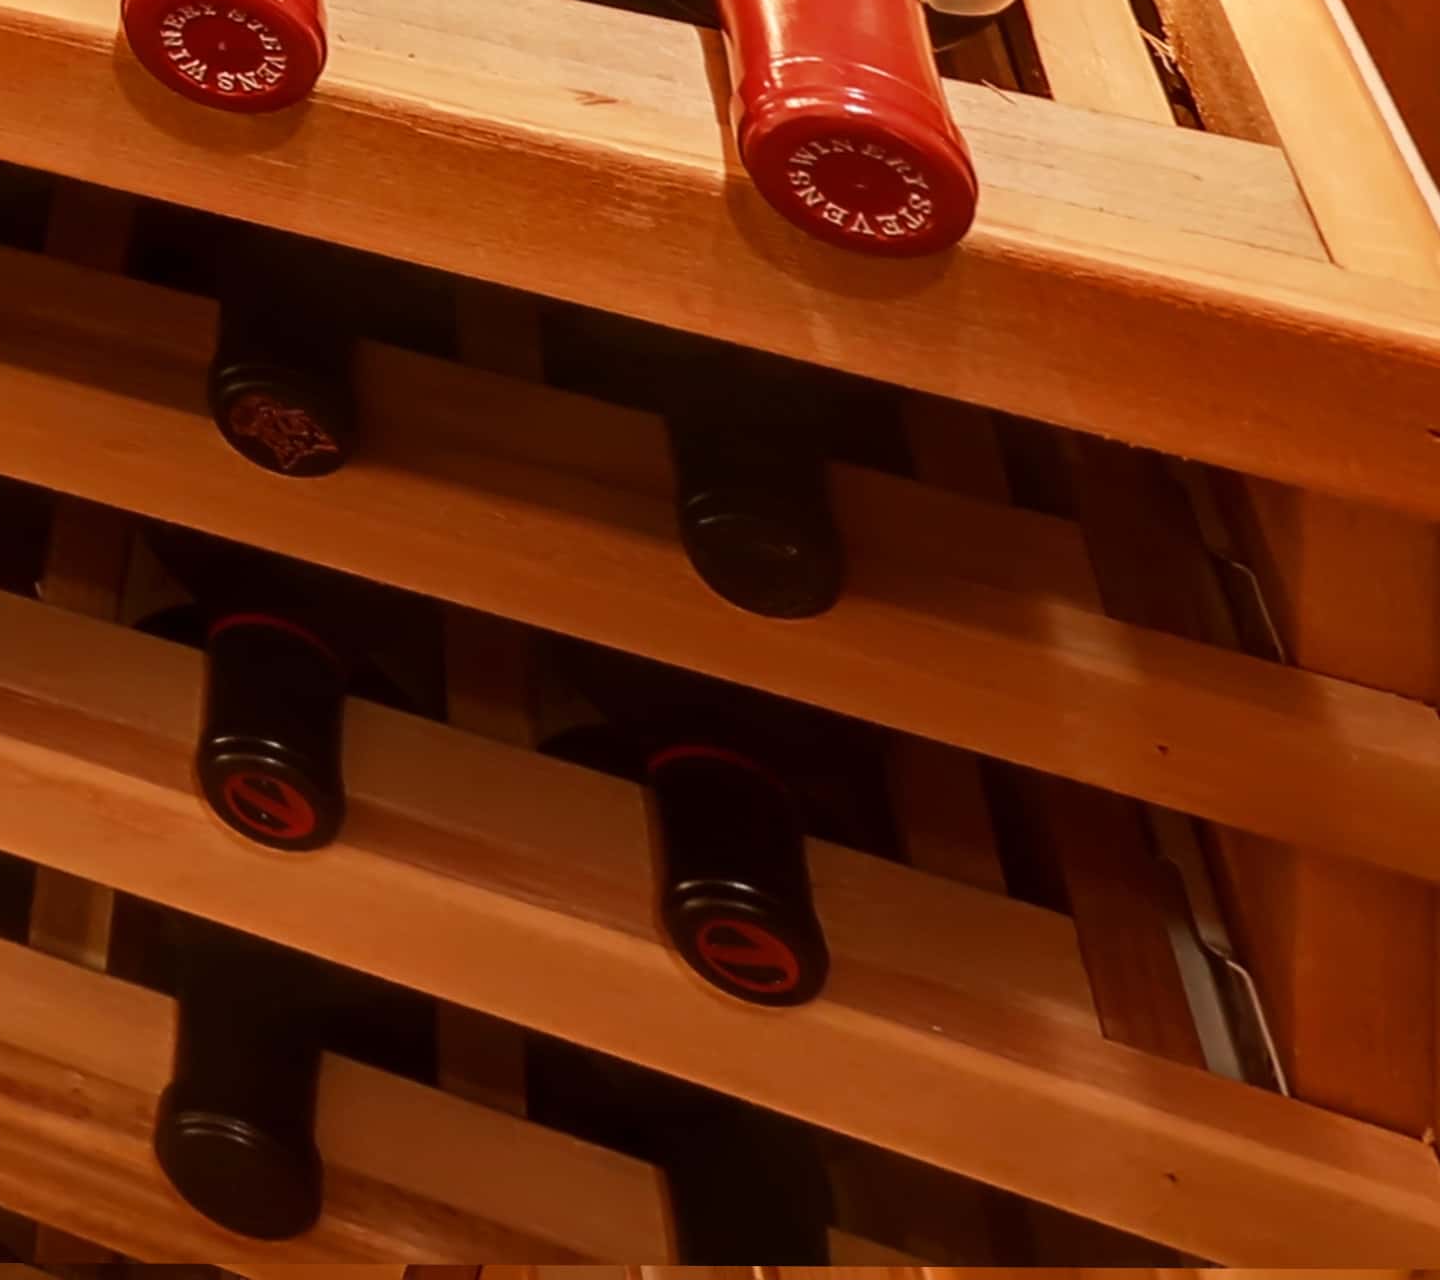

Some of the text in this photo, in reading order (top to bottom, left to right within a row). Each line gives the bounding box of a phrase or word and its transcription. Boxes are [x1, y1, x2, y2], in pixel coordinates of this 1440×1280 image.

[159, 2, 287, 91] STEVENS WINERY
[786, 138, 933, 237] STEVENS WINERY
